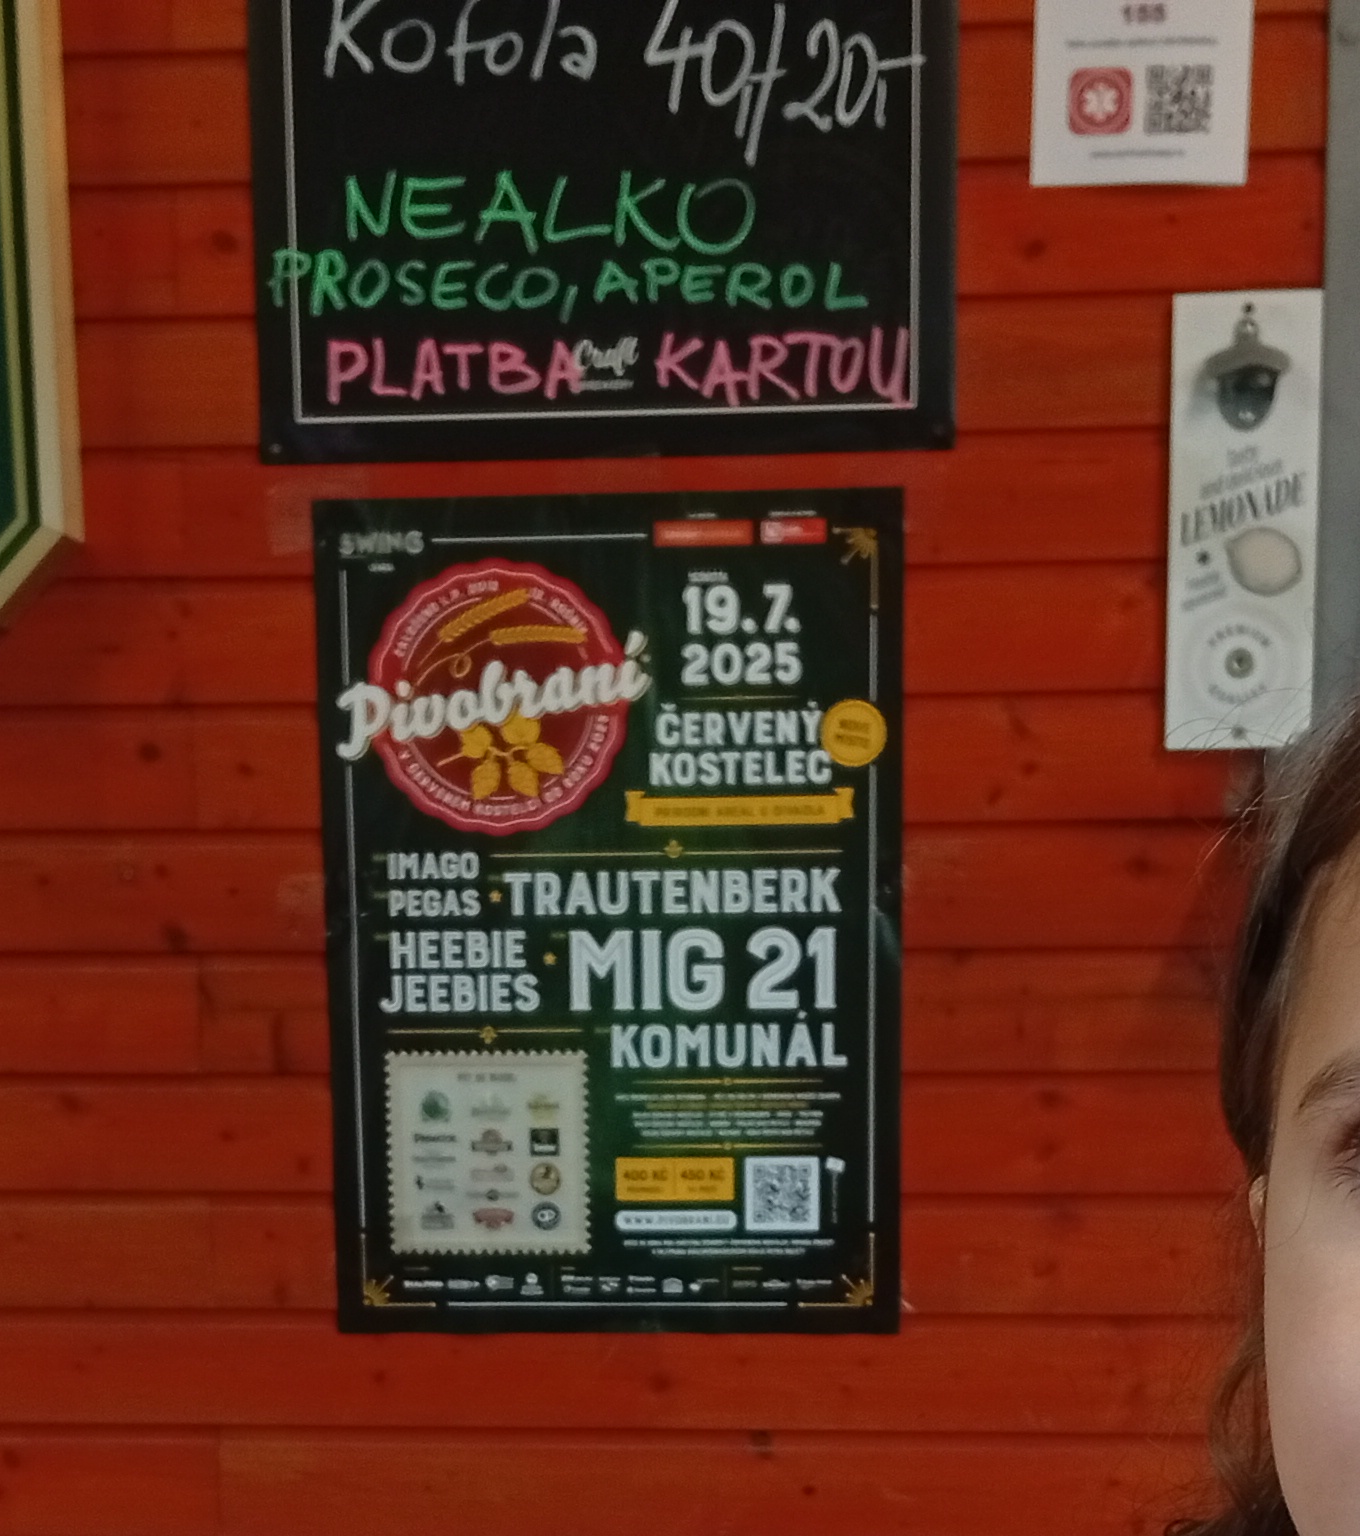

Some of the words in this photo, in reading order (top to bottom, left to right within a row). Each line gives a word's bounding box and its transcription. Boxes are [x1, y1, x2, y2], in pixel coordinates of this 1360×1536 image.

[324, 0, 599, 85] Kofola
[345, 170, 756, 255] NEALKO
[326, 336, 582, 405] PLATBA
[654, 326, 914, 408] KARTOU
[680, 640, 803, 687] 2025
[336, 630, 653, 762] Pivobraní
[655, 702, 825, 747] ČERVENÝ
[648, 748, 834, 786] KOSTELEC
[386, 852, 480, 881] IMAGO
[387, 888, 481, 918] PEGAS
[503, 867, 843, 917] TRAUTENBERK
[389, 930, 527, 970] HEEBIE
[568, 927, 726, 1012] MIG
[746, 925, 838, 1011] 21
[378, 974, 541, 1013] JEEBIES
[610, 1010, 849, 1069] KOMUNÁL
